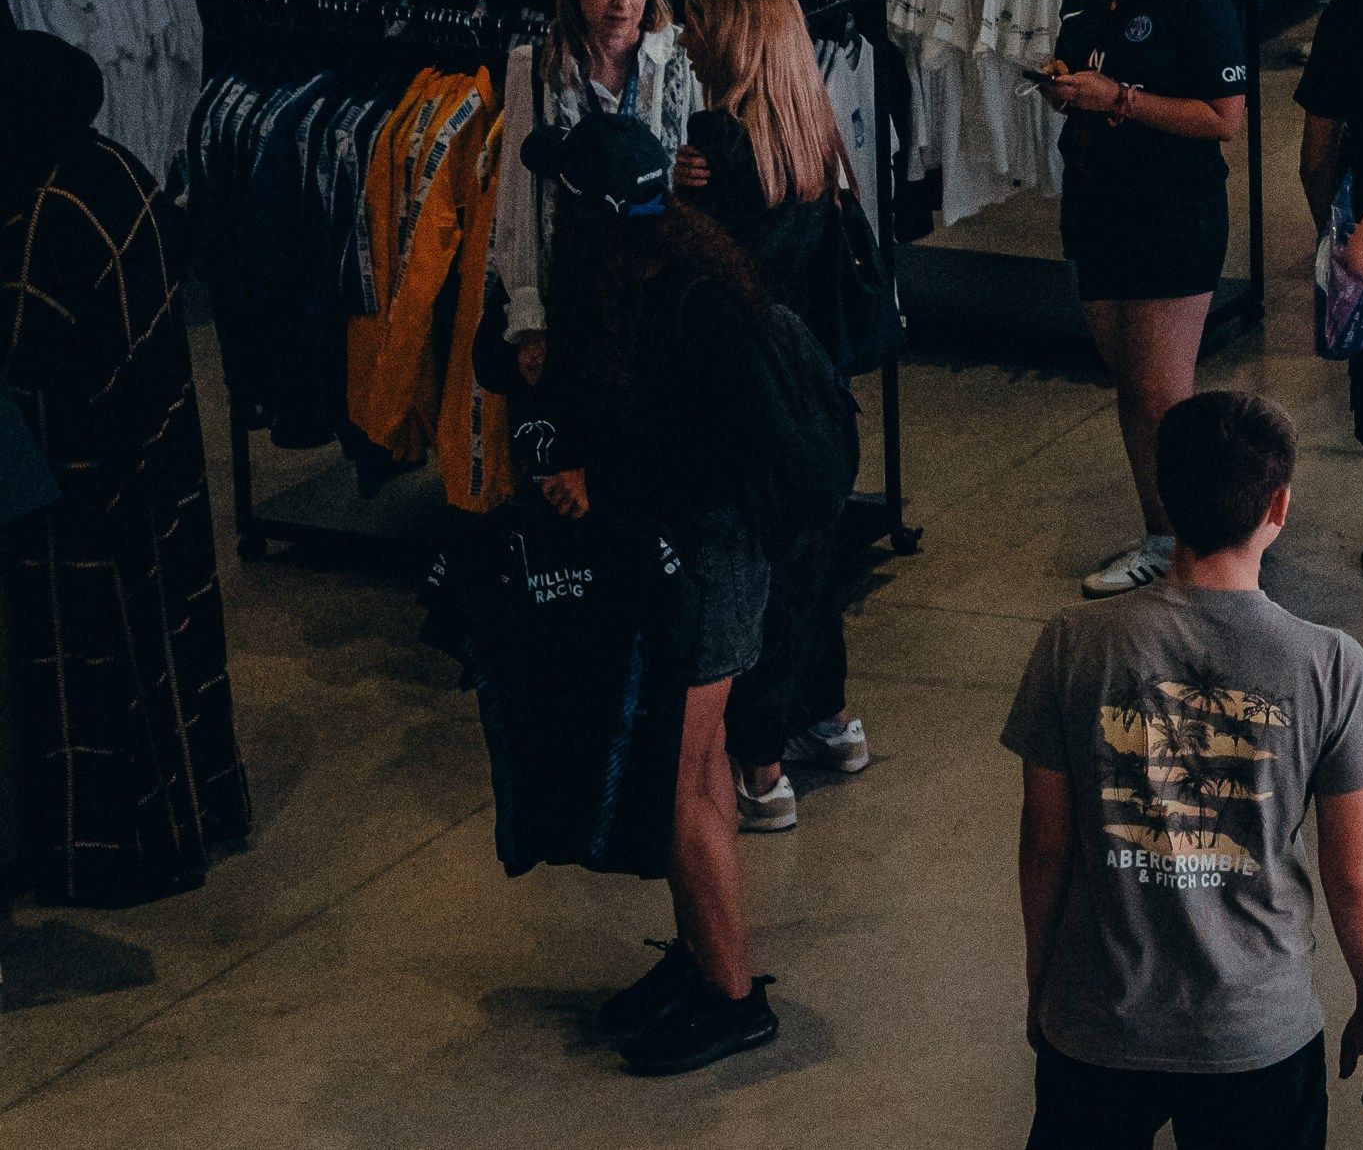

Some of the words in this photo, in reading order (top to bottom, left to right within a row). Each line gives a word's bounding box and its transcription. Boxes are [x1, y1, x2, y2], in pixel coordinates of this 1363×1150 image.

[535, 583, 585, 604] RACIG
[1106, 848, 1255, 878] ABERCROMBIE
[1138, 868, 1150, 884] &
[1155, 871, 1197, 890] FITCH
[1201, 872, 1227, 888] CO.
